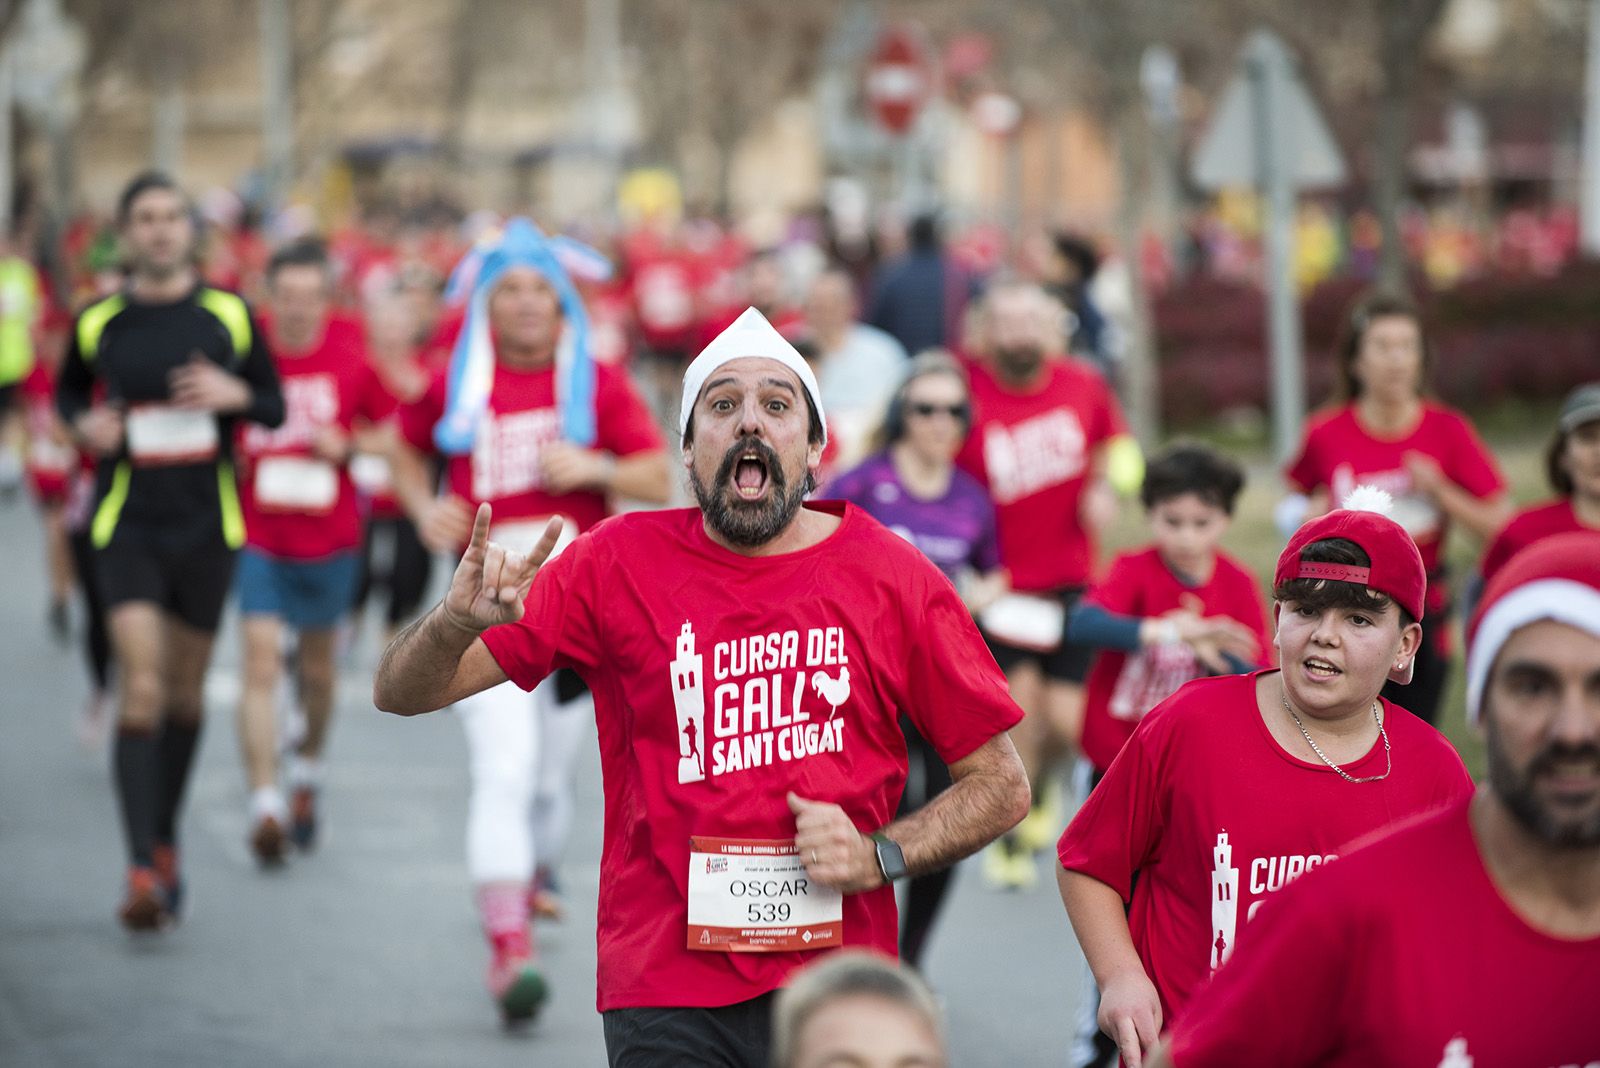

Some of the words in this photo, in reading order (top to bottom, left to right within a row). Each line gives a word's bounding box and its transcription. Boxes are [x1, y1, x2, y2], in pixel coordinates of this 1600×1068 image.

[713, 630, 799, 681] CURSA
[806, 626, 849, 667] DEL
[713, 671, 810, 738] GALL
[712, 731, 774, 776] SANT
[777, 717, 844, 762] CUGAT
[730, 879, 808, 897] OSCAR
[748, 903, 791, 923] 539
